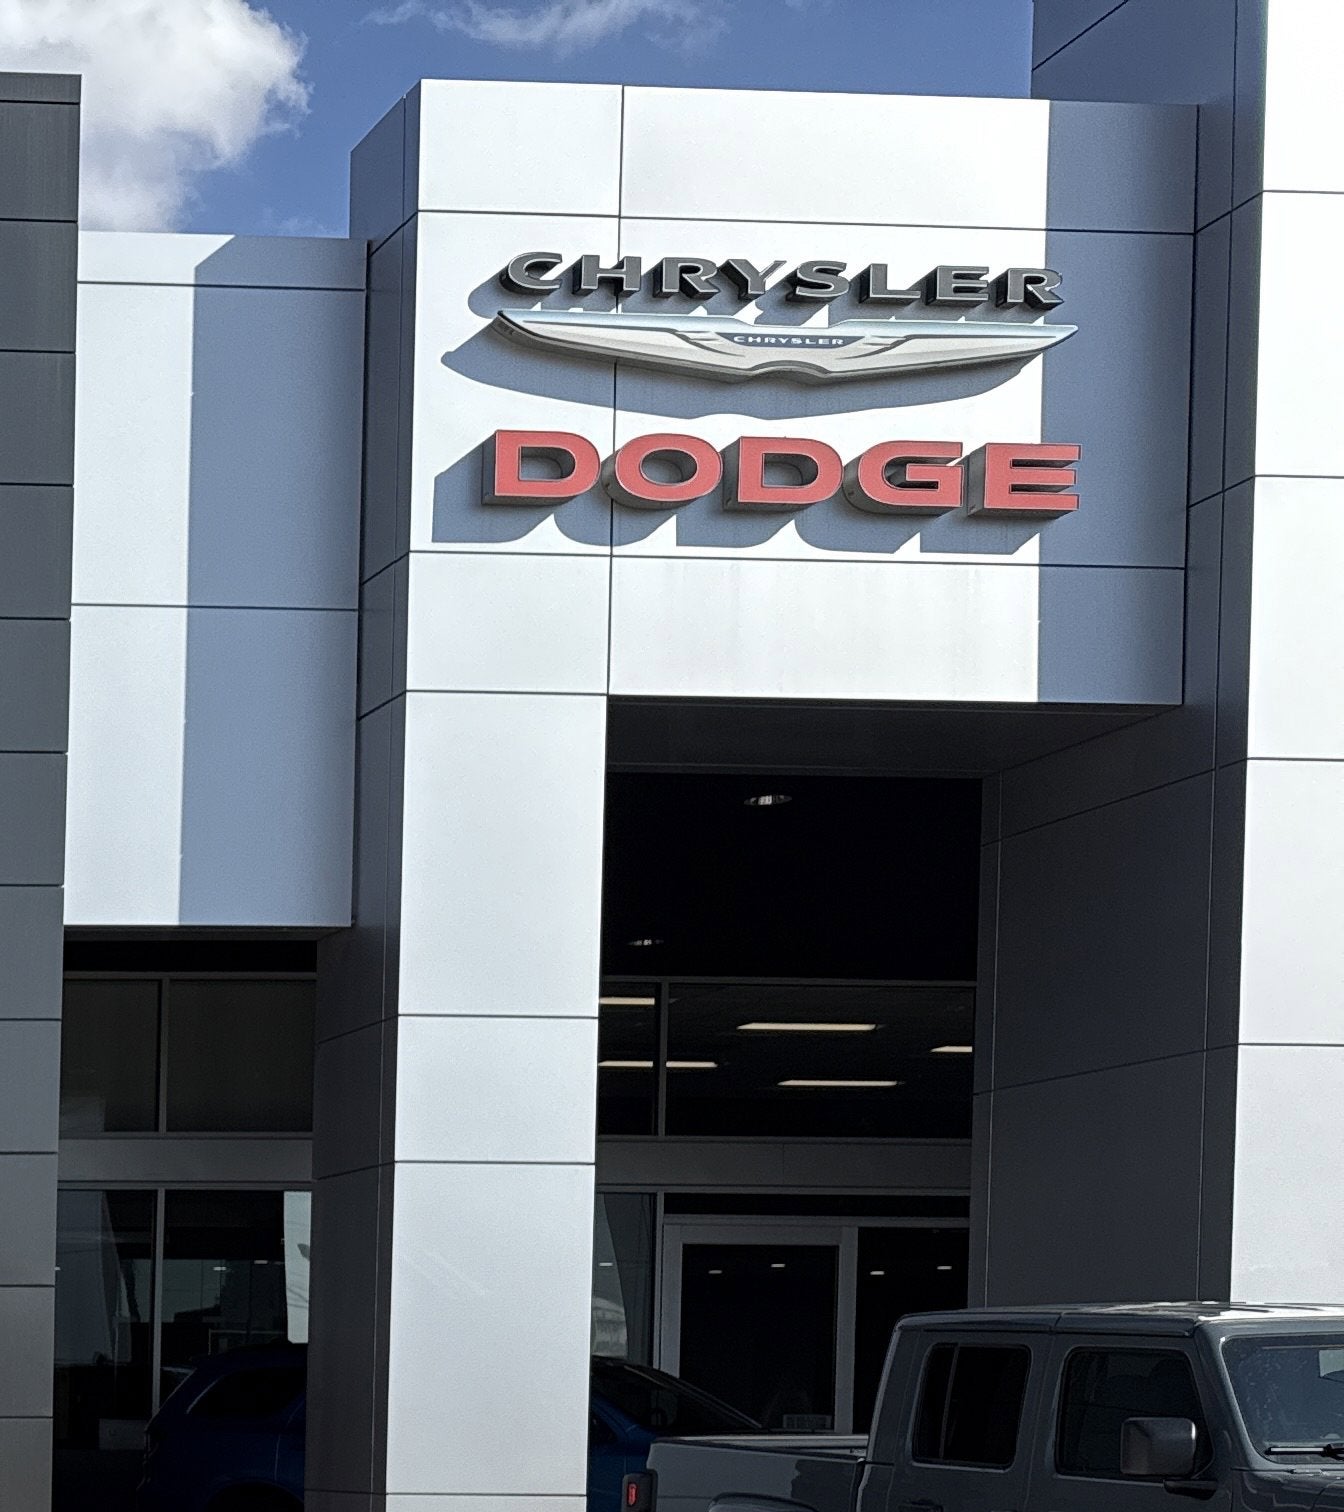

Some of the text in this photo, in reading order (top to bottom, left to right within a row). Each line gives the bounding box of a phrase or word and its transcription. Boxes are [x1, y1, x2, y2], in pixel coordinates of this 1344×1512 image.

[499, 251, 1064, 310] CHRYSLER
[732, 334, 846, 347] CHRYSLER
[490, 430, 1083, 516] DODGE
